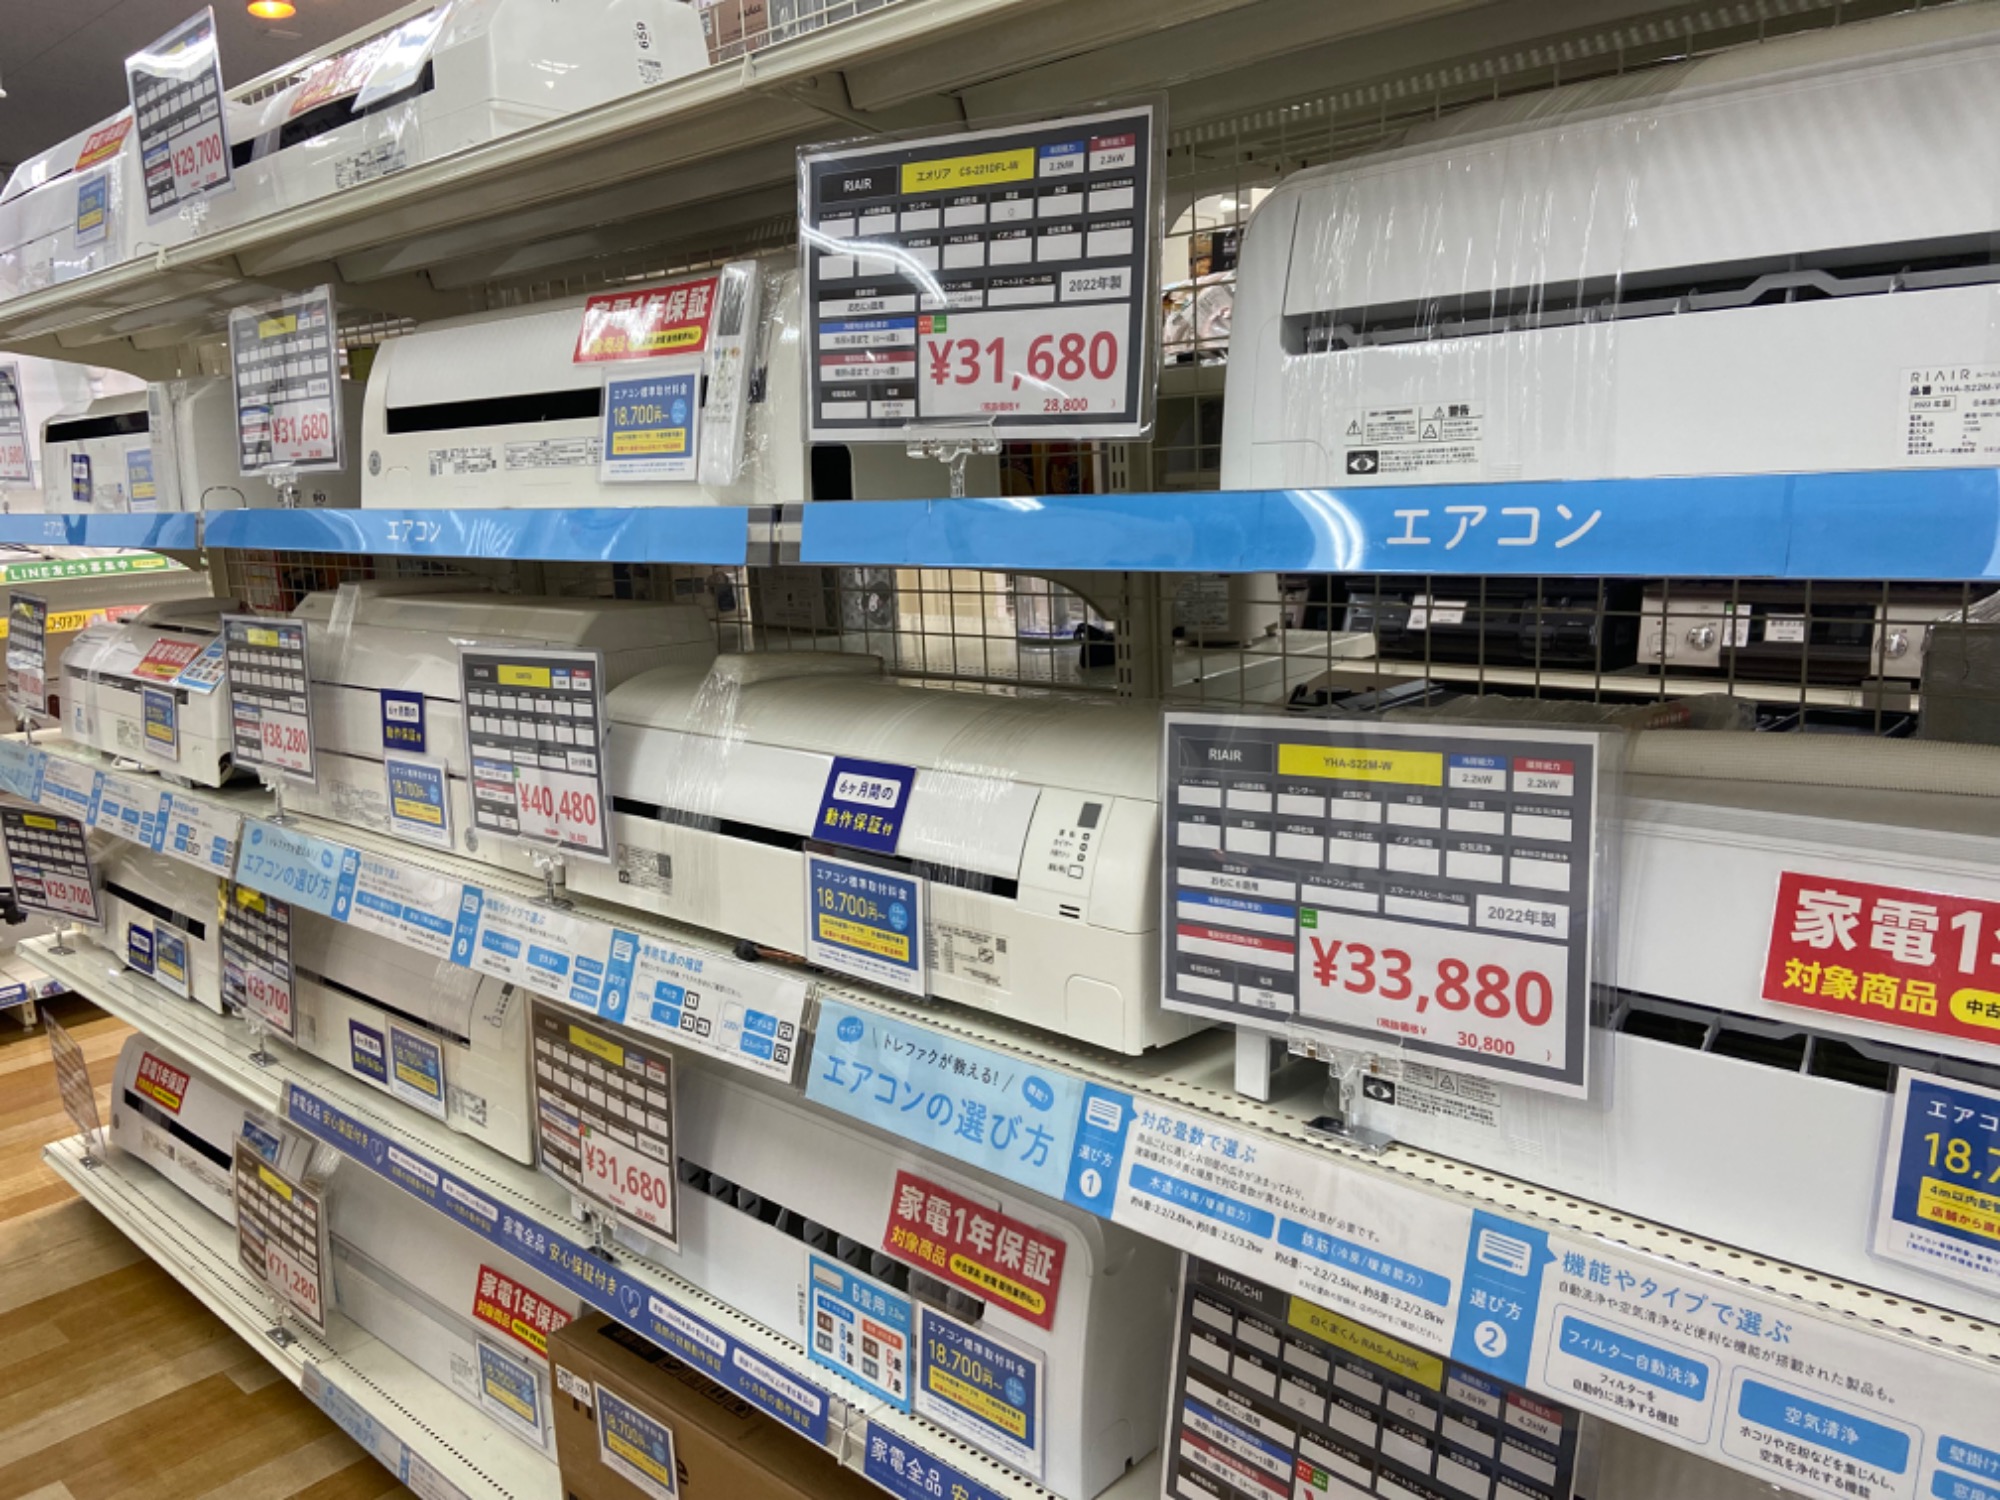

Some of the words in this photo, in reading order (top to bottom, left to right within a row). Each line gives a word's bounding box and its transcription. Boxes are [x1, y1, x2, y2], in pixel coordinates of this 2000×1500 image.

[172, 133, 222, 178] ¥29,700
[916, 168, 951, 182] エオリア
[843, 178, 872, 192] RIAIR
[1068, 274, 1122, 292] 2022年製
[927, 330, 1118, 391] ¥31,680
[1911, 368, 1971, 383] RIAIR
[1043, 397, 1089, 413] 28,800
[271, 412, 329, 446] ¥31,680
[386, 520, 441, 543] エアコン
[1386, 504, 1602, 550] エアコン
[9, 559, 129, 581] LINE友だち募集中
[262, 720, 309, 755] ¥38,280
[1208, 748, 1243, 762] RIAIR
[1323, 757, 1394, 771] YHA-S22M-W
[1462, 773, 1493, 785] 2.2kW
[1527, 777, 1560, 789] 2.2kW
[518, 781, 597, 826] ¥40,480
[838, 782, 894, 801] 6ヶ月間の
[824, 807, 894, 836] 動作保証付
[243, 854, 333, 900] エアコンの選び方
[816, 868, 908, 901] エアコン標準取付料金
[1487, 905, 1558, 928] 2022年製
[1791, 888, 2000, 975] 家電1
[1309, 936, 1554, 1027] ¥33,880
[1782, 957, 1939, 1017] 対象商品
[883, 1034, 999, 1086] トレファクが教える!
[1457, 1031, 1516, 1057] 30,800
[822, 1054, 1055, 1168] エアコンの選び方
[1077, 1144, 1115, 1167] 選び方
[1140, 1110, 1257, 1164] 対応畳数で選ぶ
[584, 1141, 667, 1209] ¥31,680
[503, 1215, 545, 1255] 家電全品
[549, 1243, 618, 1295] 安心保証付き
[890, 1225, 948, 1269] 対象商品
[896, 1183, 1056, 1286] 家電1年保証
[267, 1250, 317, 1306] ¥71,280
[1216, 1271, 1263, 1302] HITACHI
[1562, 1250, 1793, 1344] 機能やタイプで選ぶ
[852, 1282, 887, 1316] 6畳用
[1469, 1287, 1523, 1320] 選び方
[1310, 1314, 1359, 1344] 白くまくん
[1558, 1280, 1896, 1404] 自動洗浄や空気清浄など便利な機能が搭載された製品も。
[928, 1321, 1027, 1379] エアコン標準取付料金
[1567, 1328, 1700, 1389] フィルター自動洗浄
[1572, 1378, 1680, 1427] 自動的に洗浄する機能
[1600, 1373, 1657, 1404] フィルターを
[1784, 1405, 1860, 1446] 空気清浄
[870, 1436, 943, 1498] 家電全品
[1739, 1425, 1896, 1492] ホコリや花粉などを集じんし、
[1759, 1448, 1872, 1500] 空気を浄化する機能
